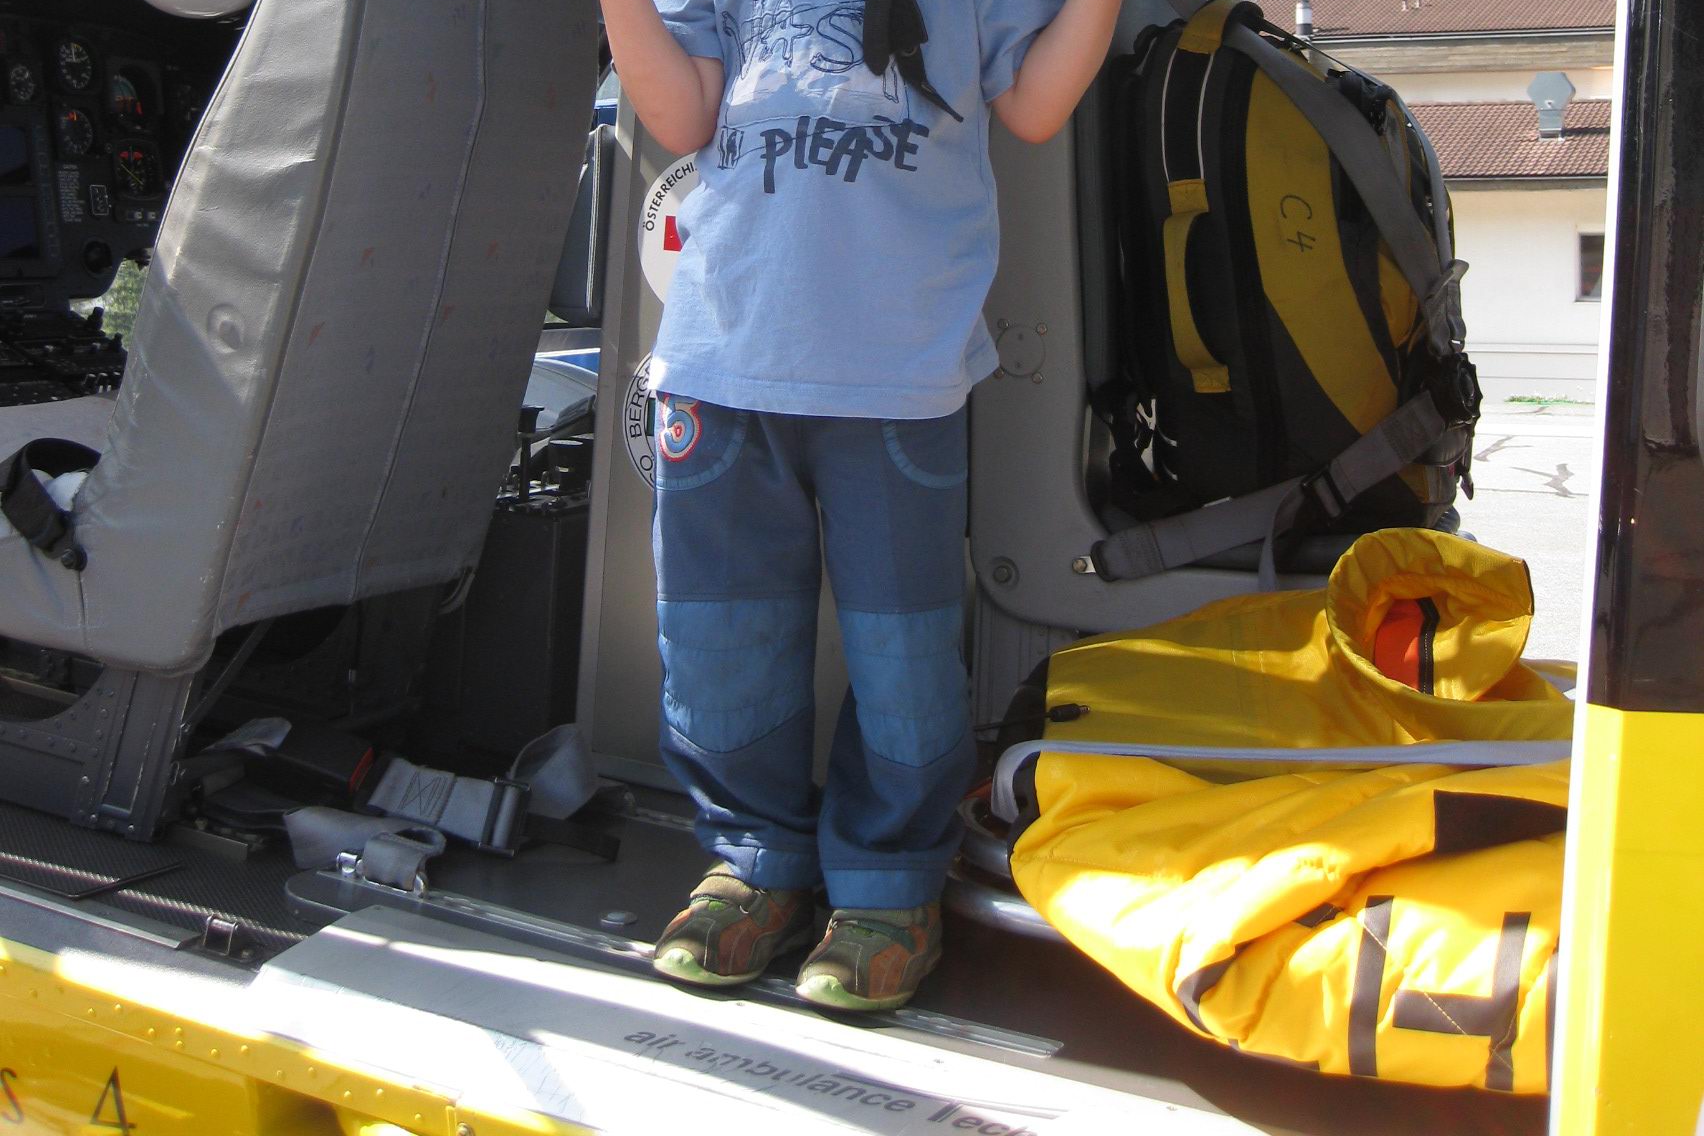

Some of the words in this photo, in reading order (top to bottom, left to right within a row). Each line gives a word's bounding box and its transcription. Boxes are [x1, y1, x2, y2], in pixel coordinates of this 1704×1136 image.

[642, 162, 698, 232] ÖSTERREICHI
[624, 1026, 686, 1051] air
[686, 1042, 916, 1114] ambulance
